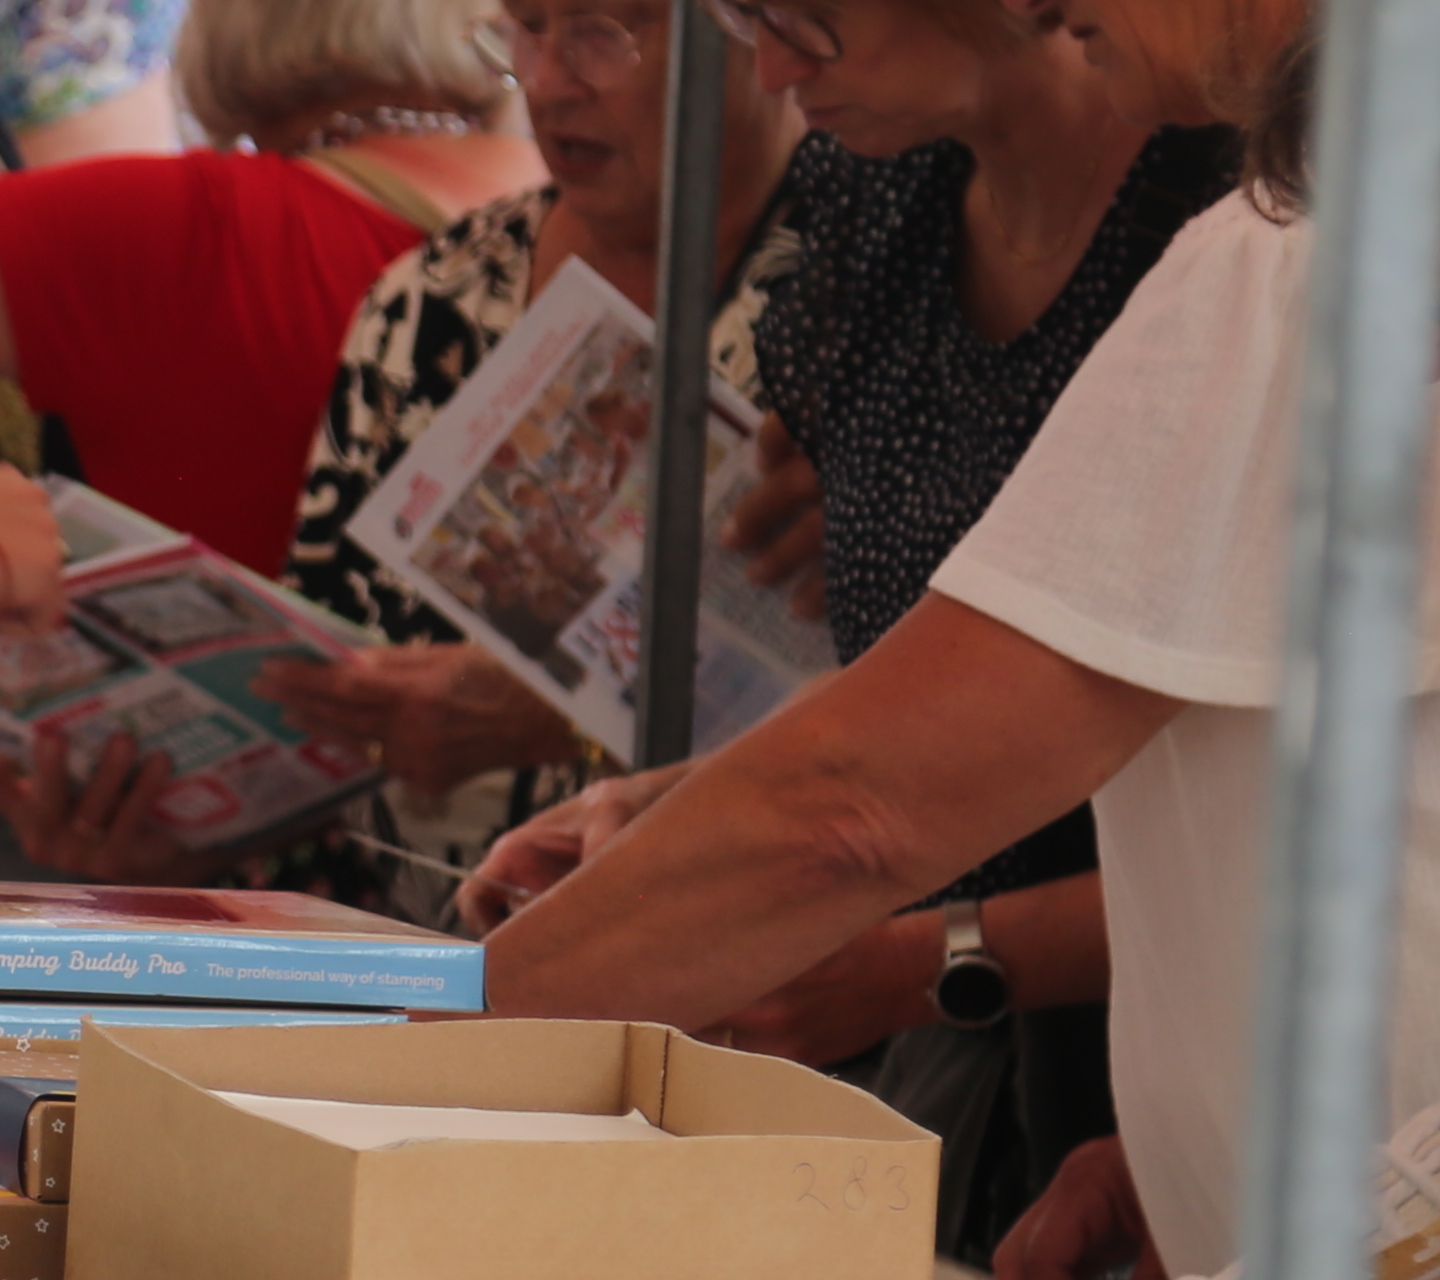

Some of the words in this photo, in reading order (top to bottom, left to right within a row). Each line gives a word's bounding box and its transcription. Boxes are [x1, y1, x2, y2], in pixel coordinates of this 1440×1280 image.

[67, 949, 141, 979] Buddy
[146, 952, 187, 975] Pro
[206, 962, 235, 978] The
[236, 964, 326, 983] professional
[327, 972, 358, 988] way
[359, 970, 375, 985] of
[376, 973, 445, 991] stamping
